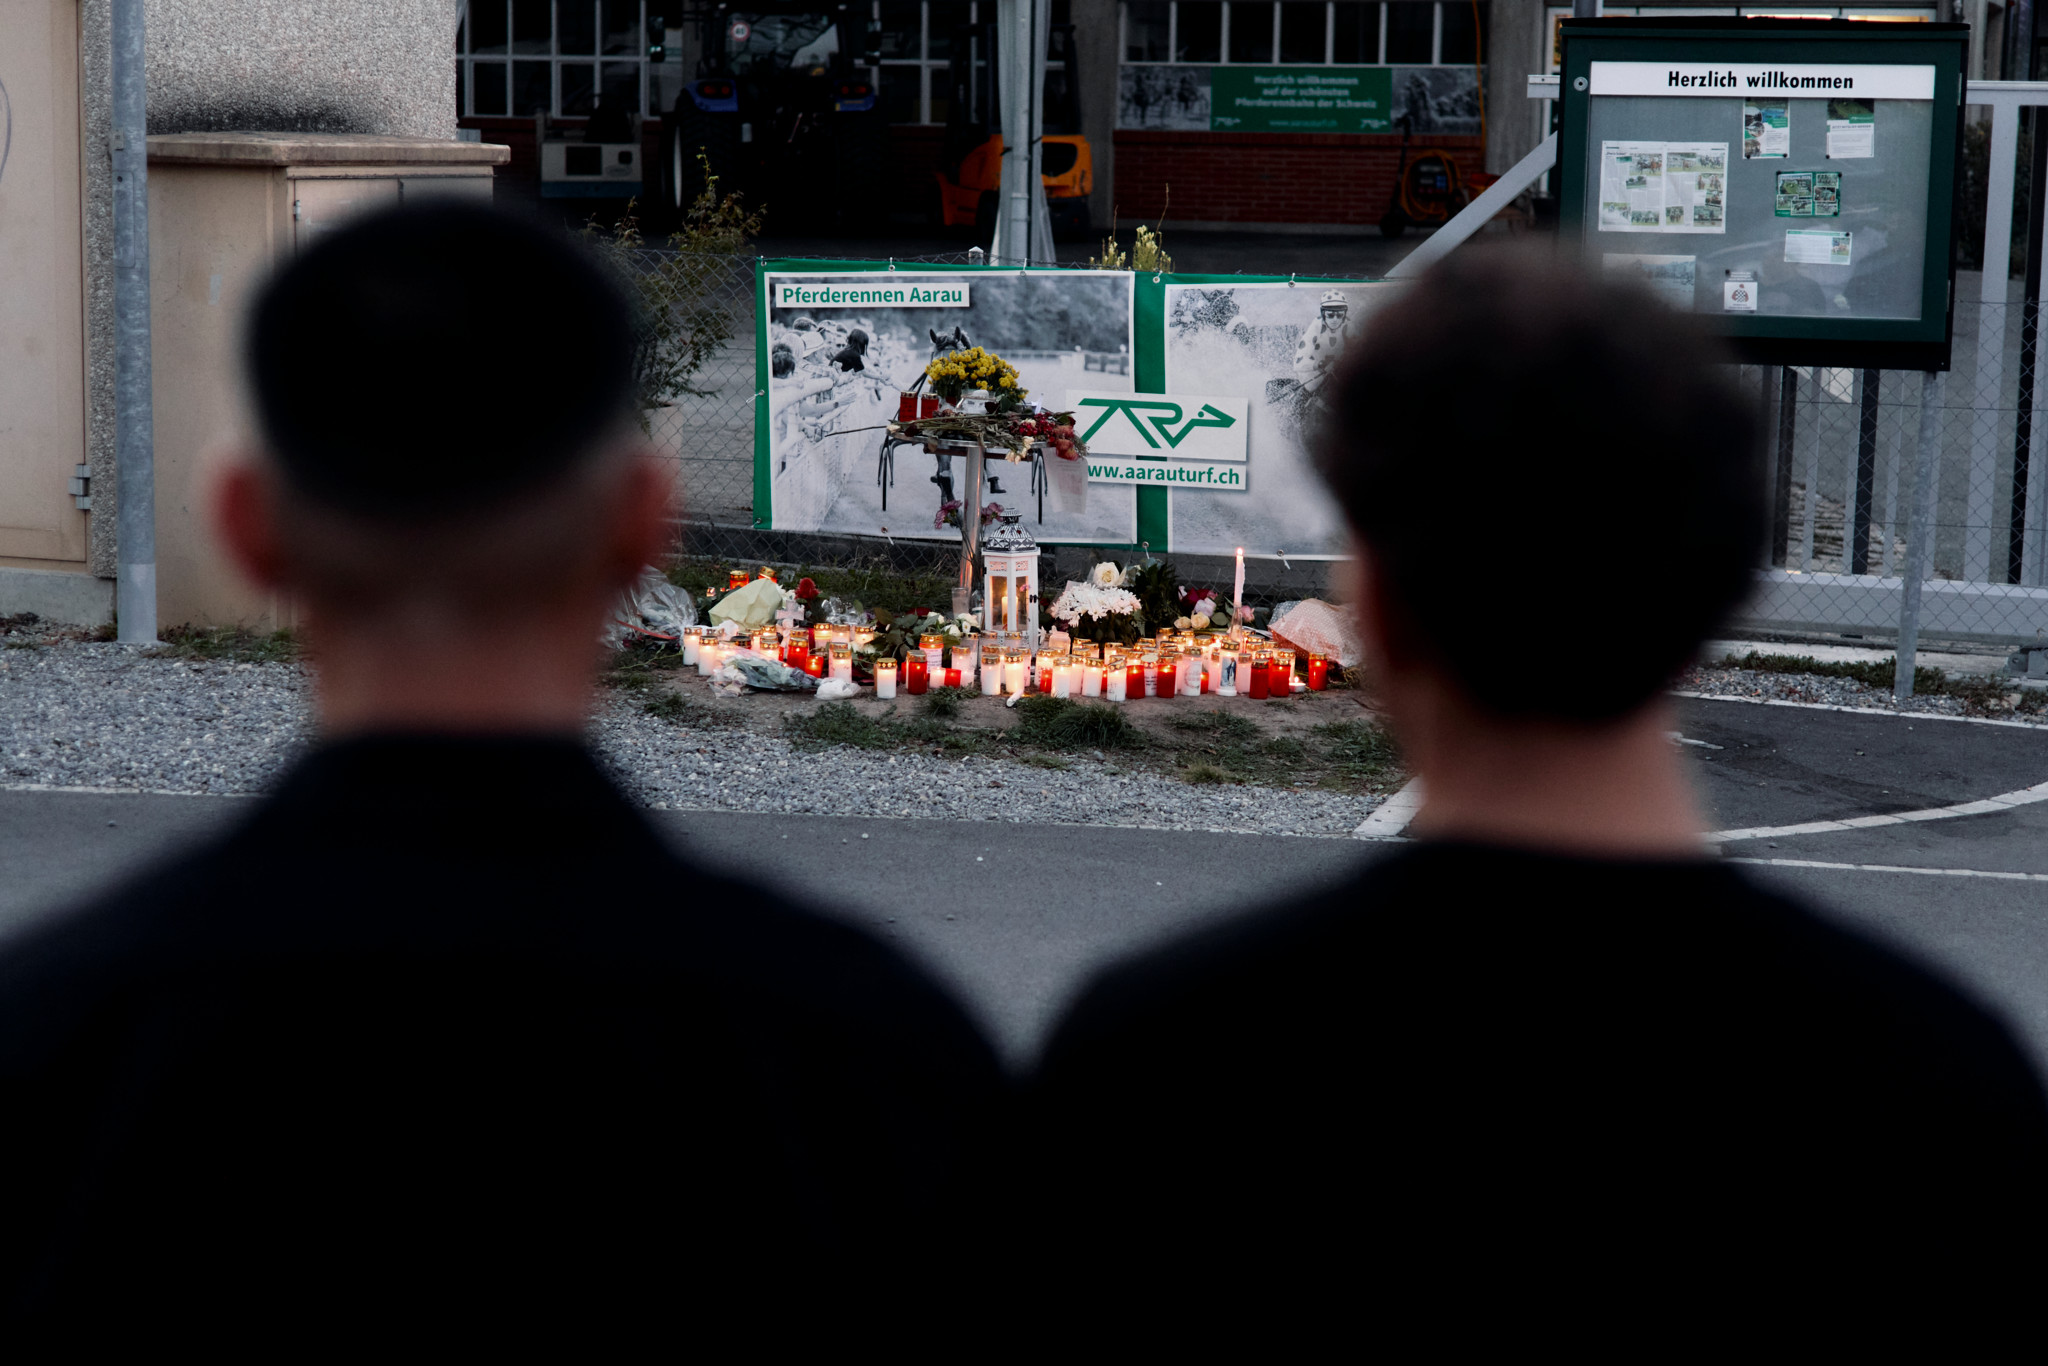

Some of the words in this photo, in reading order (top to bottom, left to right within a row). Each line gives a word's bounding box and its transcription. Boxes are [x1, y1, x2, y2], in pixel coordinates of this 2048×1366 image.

[1254, 75, 1294, 84] Herzlich
[1297, 75, 1359, 85] willkommen
[1668, 70, 1737, 88] Herzlich
[1746, 71, 1854, 89] willkommen
[1262, 87, 1279, 96] auf
[1281, 87, 1297, 96] der
[1299, 87, 1350, 96] schönsten
[1235, 97, 1315, 107] Pferderennbahn
[1317, 98, 1334, 107] der
[1336, 98, 1377, 109] Schweiz
[783, 287, 905, 303] Pferderennen
[909, 287, 962, 303] Aarau
[1088, 465, 1240, 485] ww.aarauturf.ch
